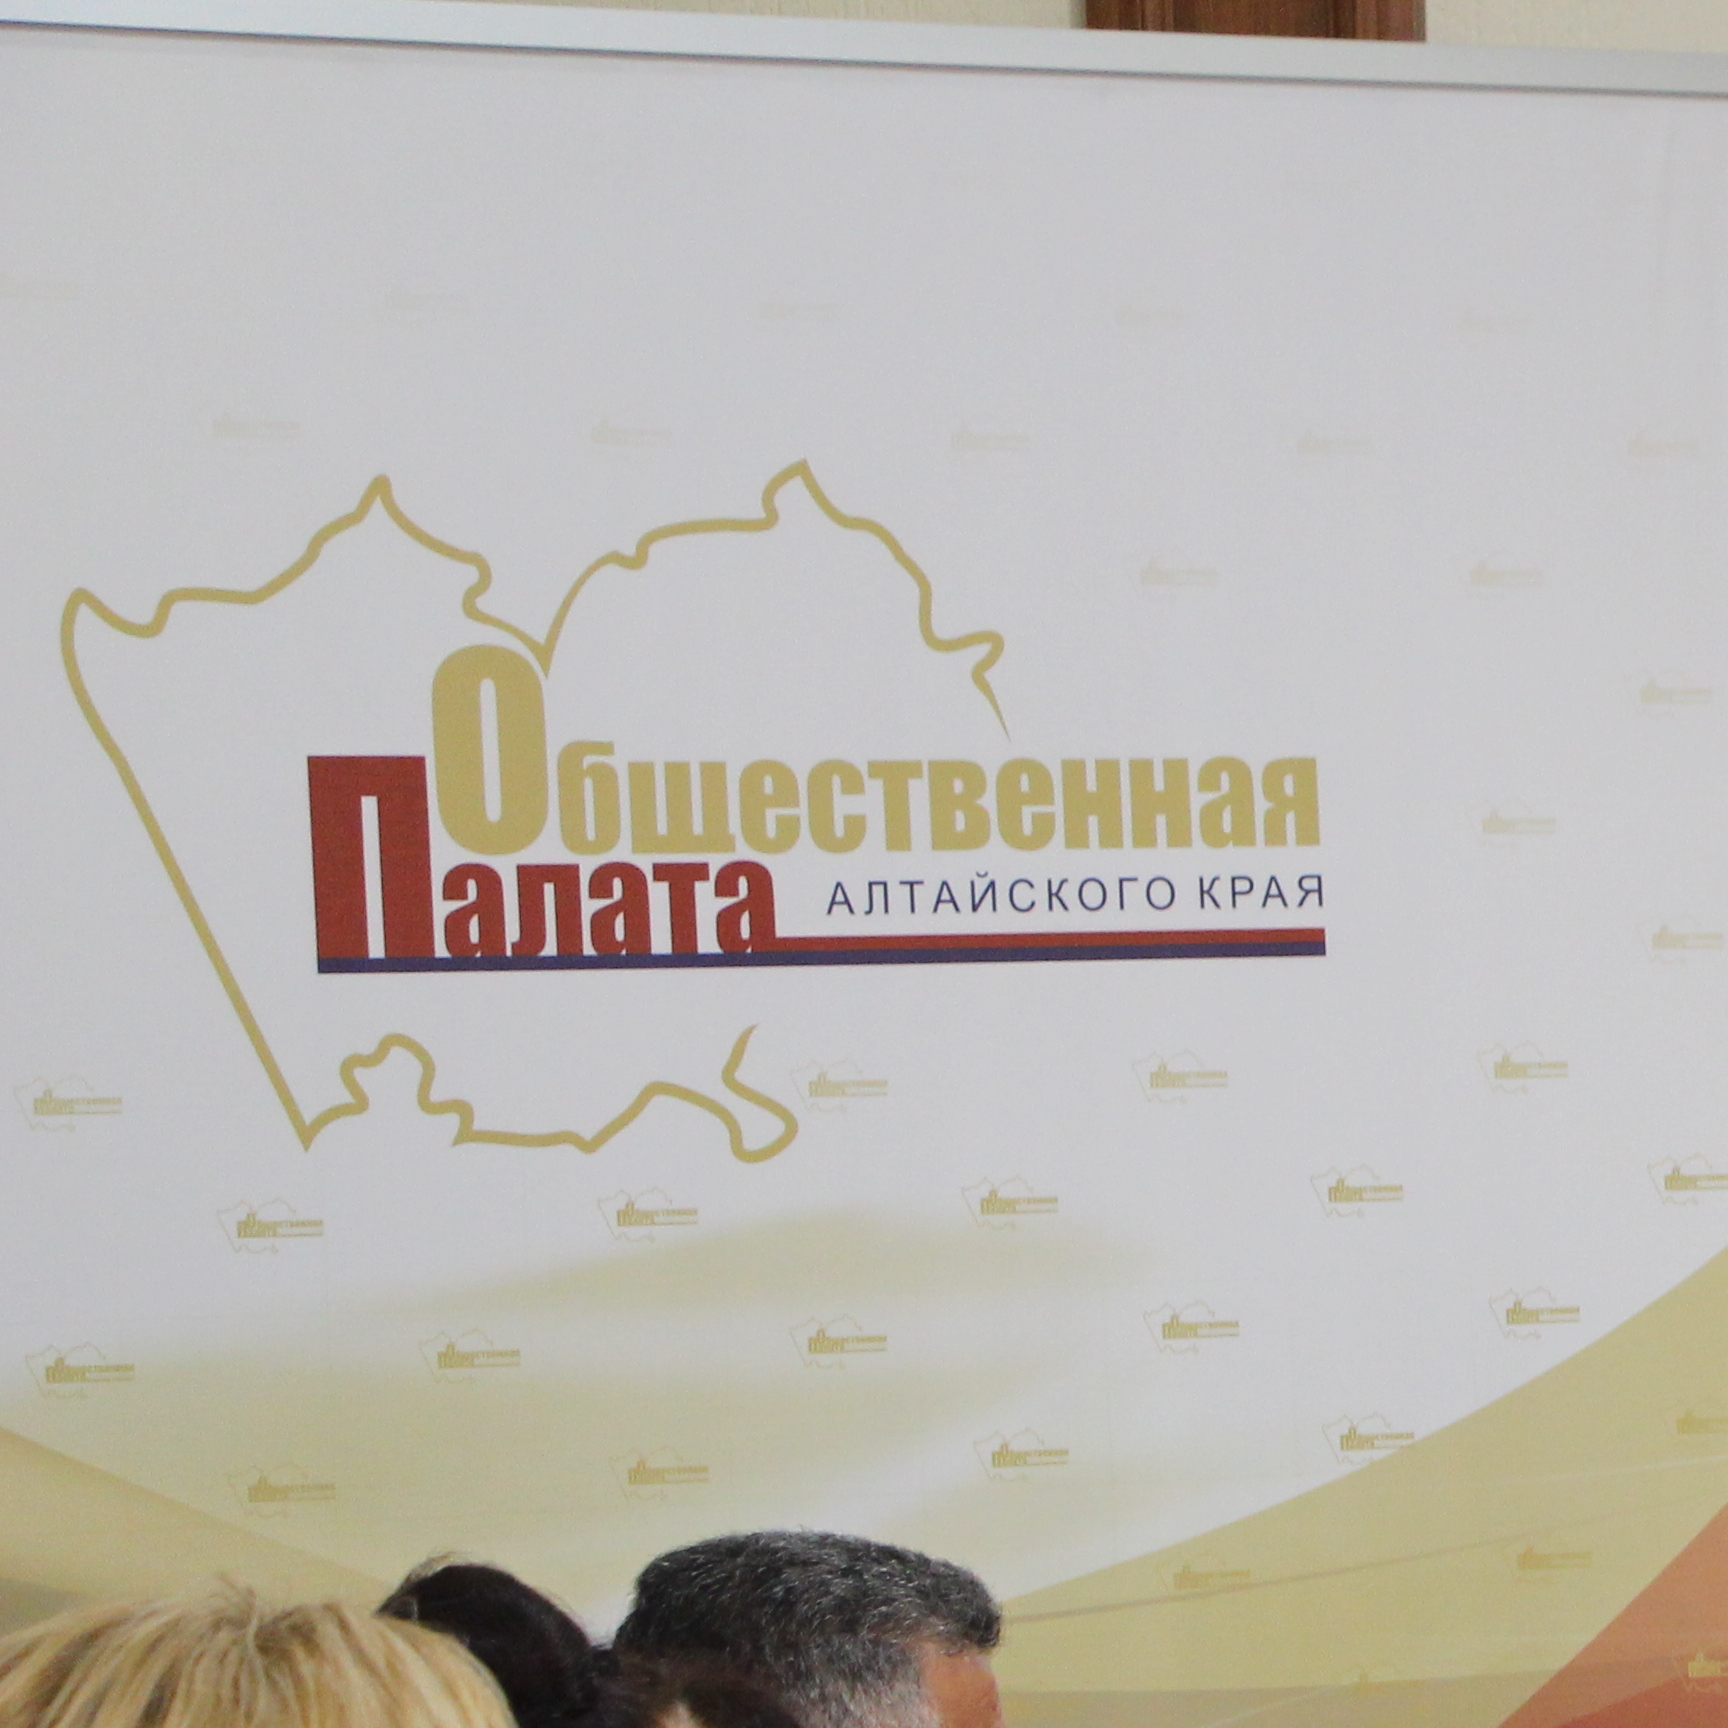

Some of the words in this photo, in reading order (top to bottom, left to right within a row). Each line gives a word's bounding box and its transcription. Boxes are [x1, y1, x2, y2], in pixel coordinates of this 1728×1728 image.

[431, 644, 1321, 856] Общественная
[308, 756, 776, 958] Палата
[826, 871, 1177, 915] АЛТАЙСКОГО
[1199, 873, 1325, 911] КРАЯ
